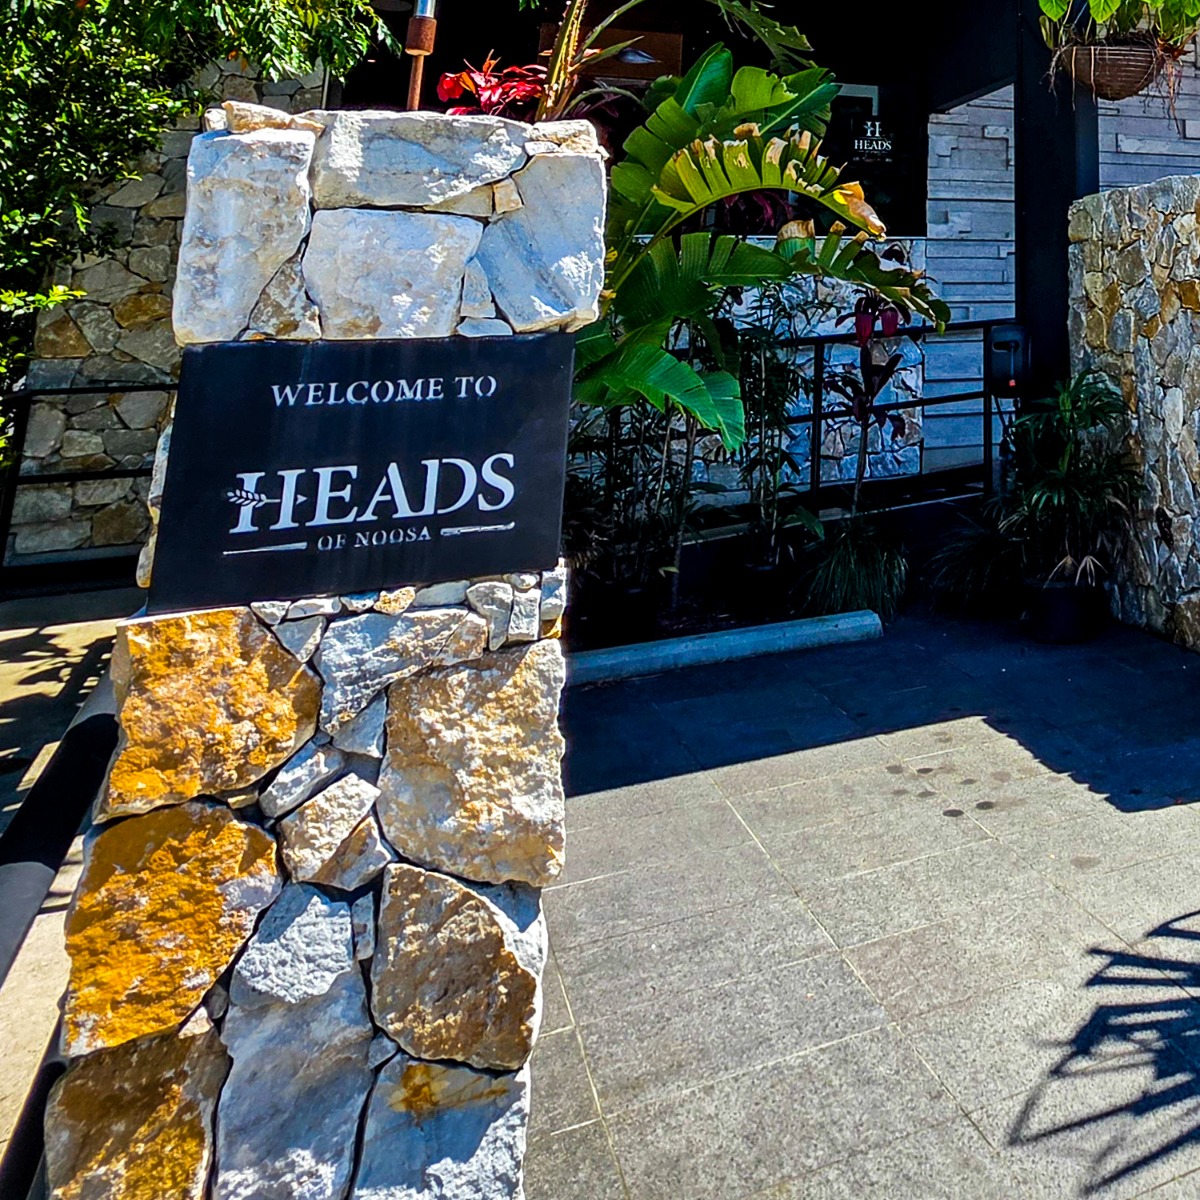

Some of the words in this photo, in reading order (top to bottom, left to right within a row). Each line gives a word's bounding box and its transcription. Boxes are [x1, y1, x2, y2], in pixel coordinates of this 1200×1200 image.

[854, 139, 892, 151] HEADS
[271, 377, 445, 407] WELCOME
[455, 375, 498, 398] TO
[228, 452, 516, 534] HEADS
[317, 533, 346, 551] OF
[353, 526, 432, 548] NOOSA
